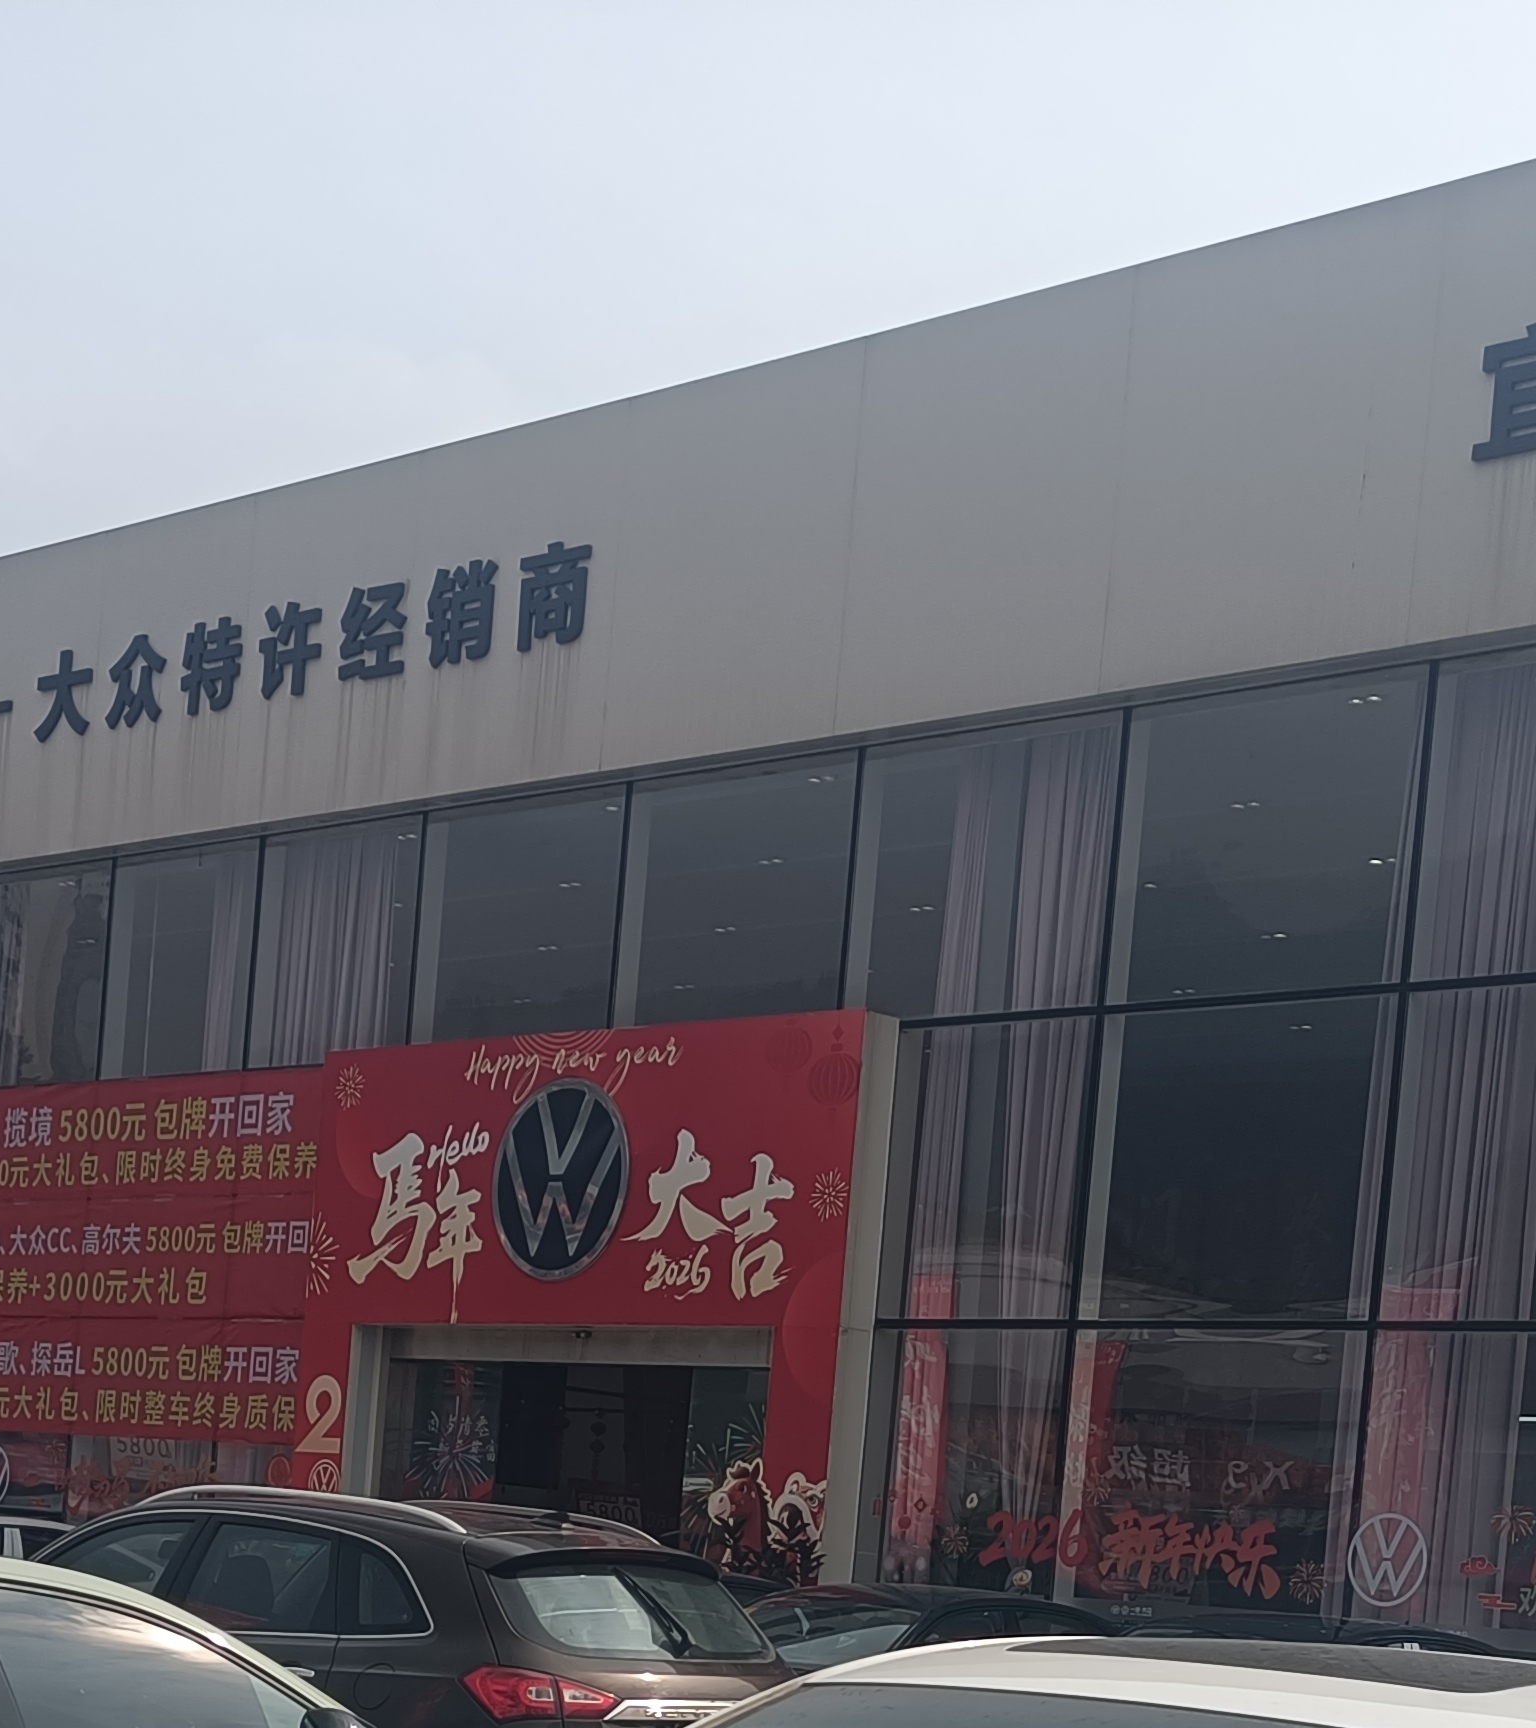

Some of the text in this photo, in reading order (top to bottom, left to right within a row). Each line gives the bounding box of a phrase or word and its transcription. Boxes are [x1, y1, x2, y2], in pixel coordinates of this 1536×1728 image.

[464, 1036, 685, 1104] Happy new year
[59, 1101, 147, 1145] 5800元
[153, 1091, 295, 1141] 包牌开回家
[426, 1121, 490, 1190] Hello
[145, 1222, 217, 1255] 5800元
[619, 1128, 796, 1301] 大吉
[644, 1245, 712, 1301] 2026
[91, 1345, 170, 1381] 5800元
[174, 1344, 301, 1386] 包牌开回家
[979, 1501, 1282, 1601] 2026 新年快乐
